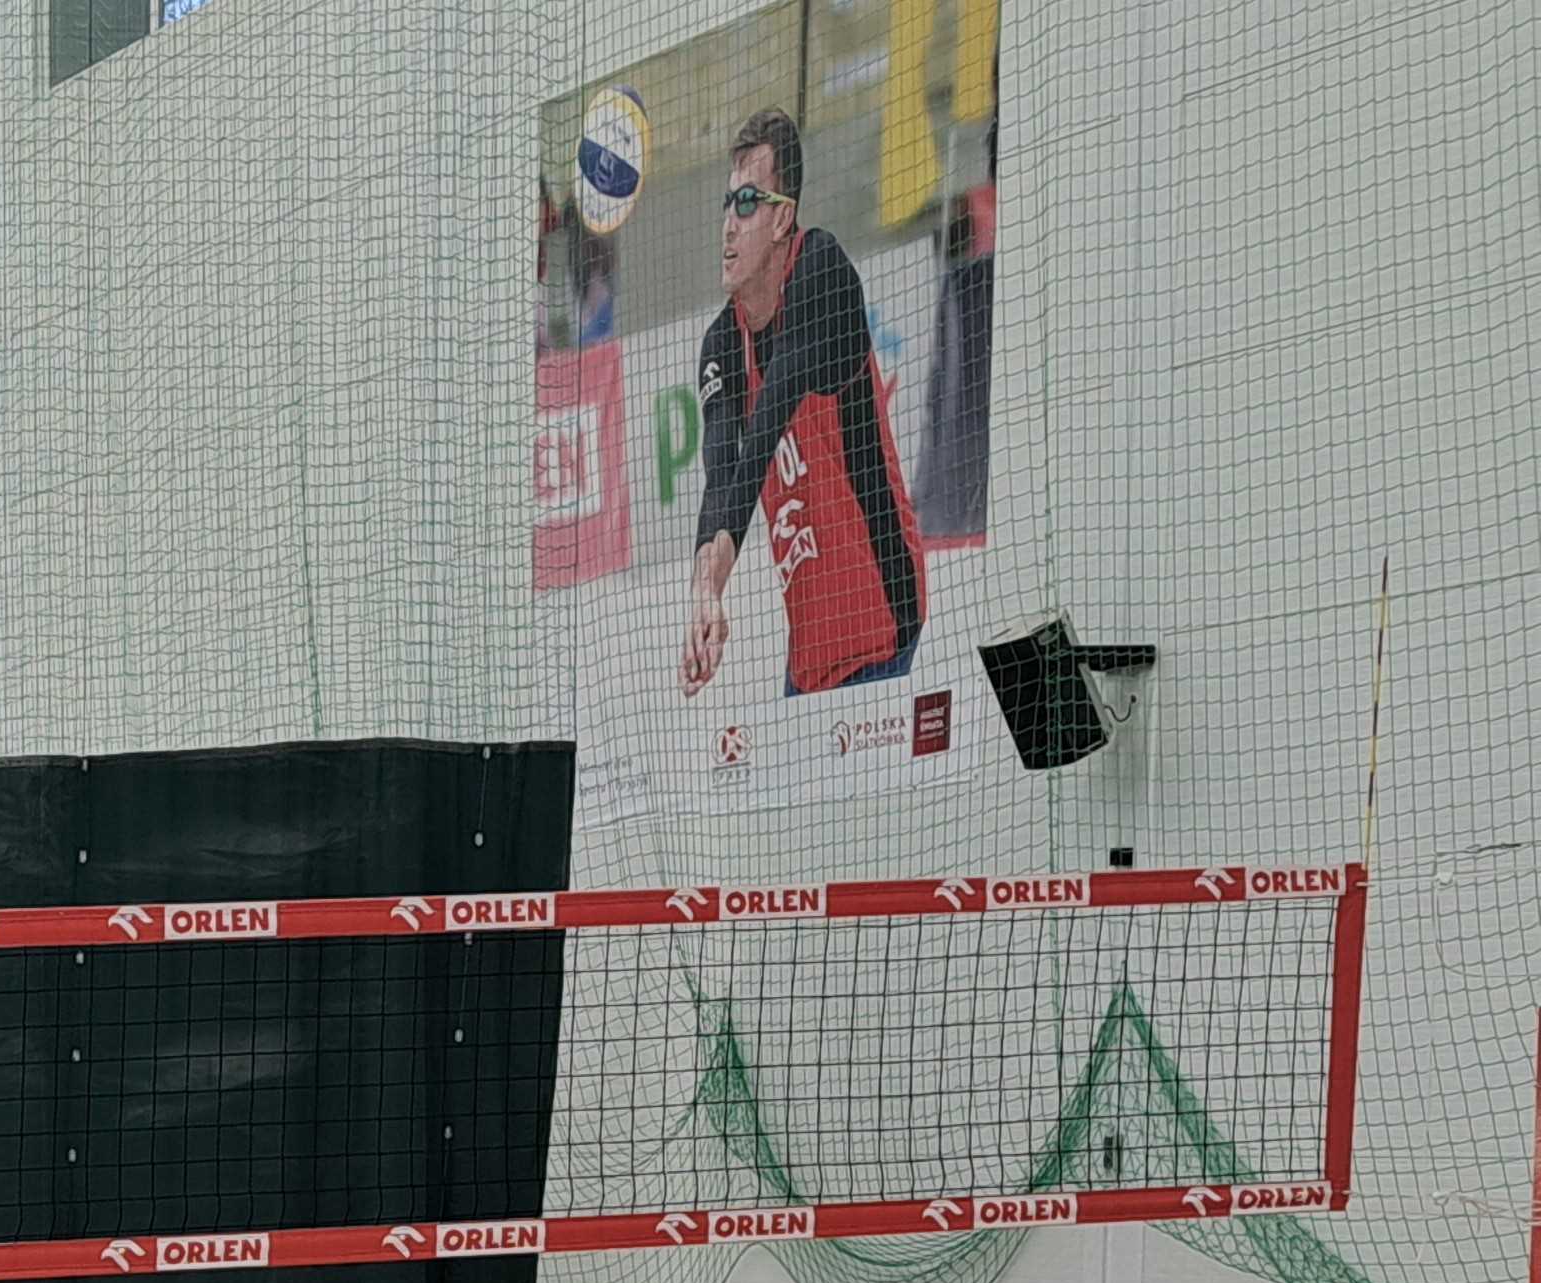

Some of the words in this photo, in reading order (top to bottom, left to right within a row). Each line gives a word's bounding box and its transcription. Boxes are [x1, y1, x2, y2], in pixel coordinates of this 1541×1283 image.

[855, 716, 906, 735] POLSKA
[170, 906, 271, 936] ORLEN
[450, 899, 549, 926] ORLEN
[724, 887, 822, 918] ORLEN
[992, 879, 1085, 905] ORLEN
[1252, 870, 1341, 894] ORLEN
[163, 1238, 266, 1265] ORLEN
[443, 1225, 540, 1253] ORLEN
[715, 1214, 807, 1239] ORLEN
[979, 1199, 1072, 1225] ORLEN
[1236, 1186, 1326, 1210] ORLEN
